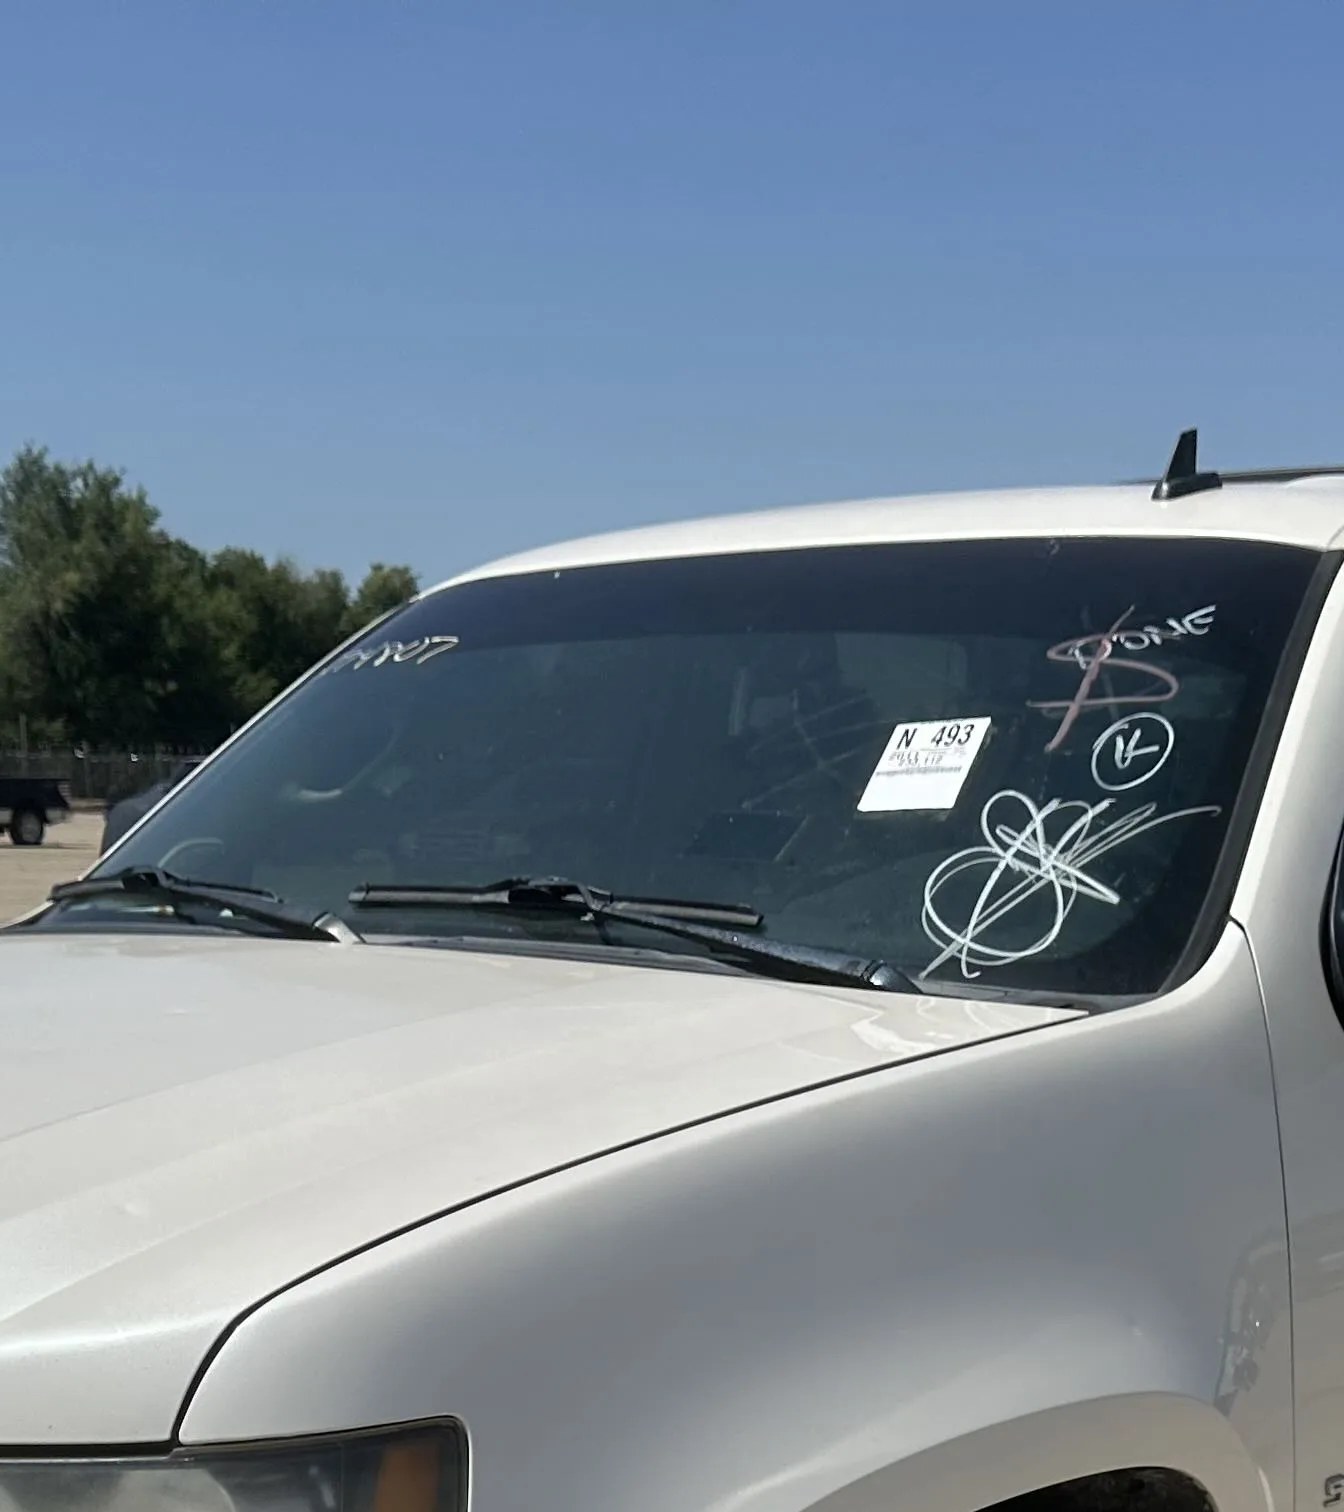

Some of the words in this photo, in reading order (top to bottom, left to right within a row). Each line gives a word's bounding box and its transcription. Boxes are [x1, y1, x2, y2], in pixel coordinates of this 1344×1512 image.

[1068, 604, 1218, 669] DONE
[896, 728, 918, 750] N
[931, 723, 975, 747] 493
